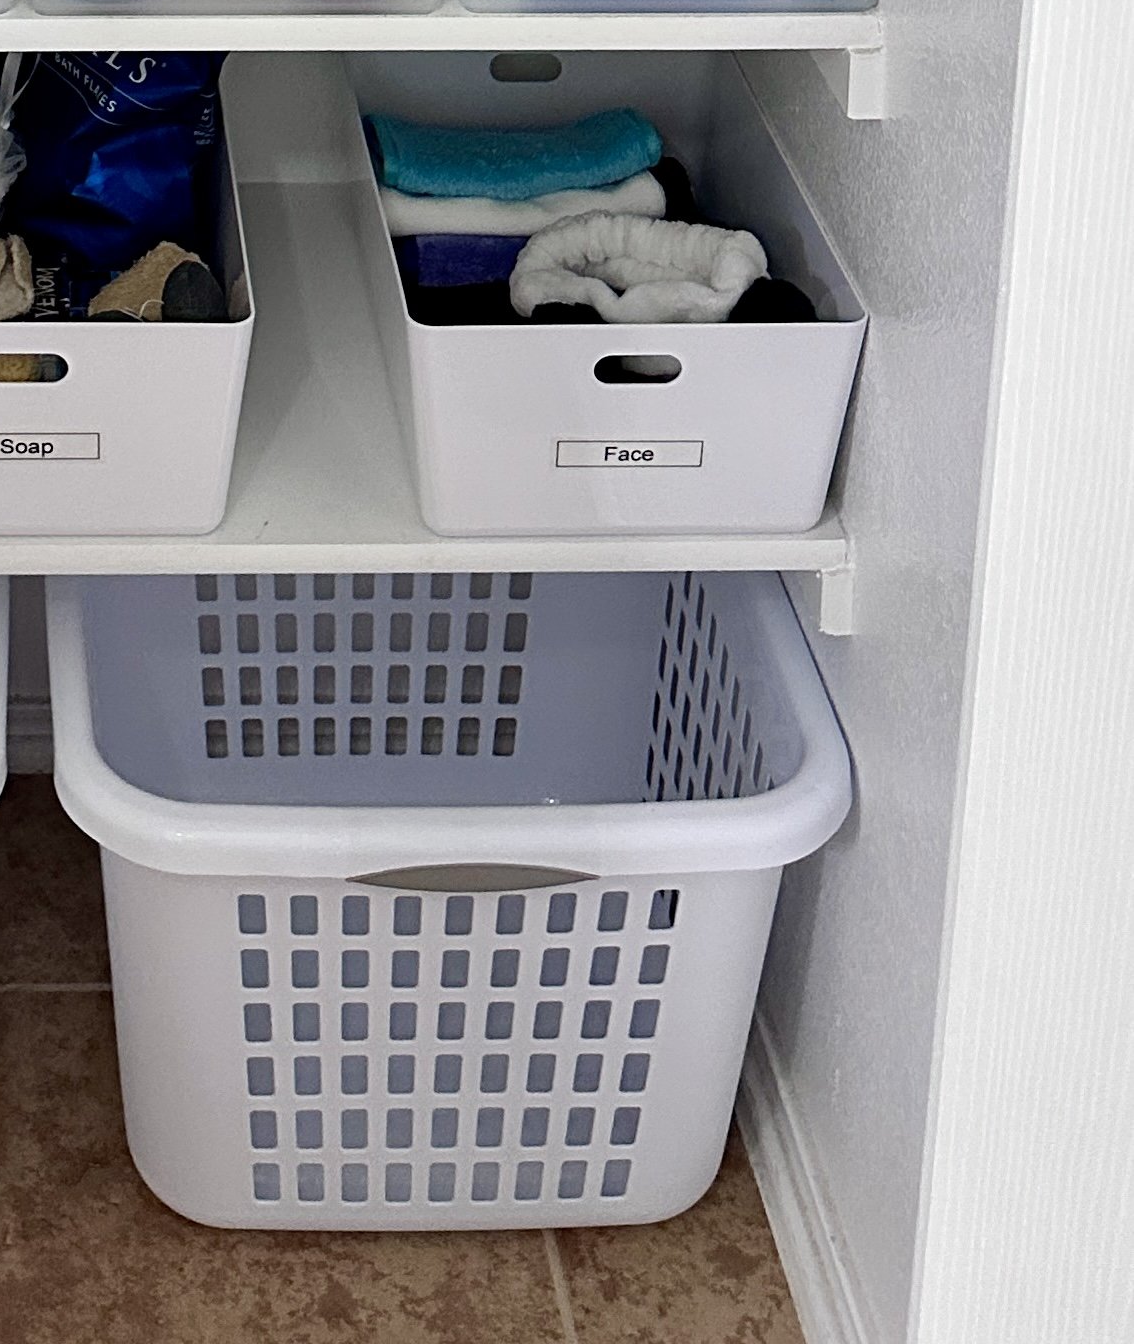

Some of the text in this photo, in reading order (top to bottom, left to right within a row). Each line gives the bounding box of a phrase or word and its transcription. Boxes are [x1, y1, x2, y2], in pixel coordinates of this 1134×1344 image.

[33, 266, 61, 319] VENOM
[1, 439, 53, 457] Soap
[605, 447, 654, 461] Face
